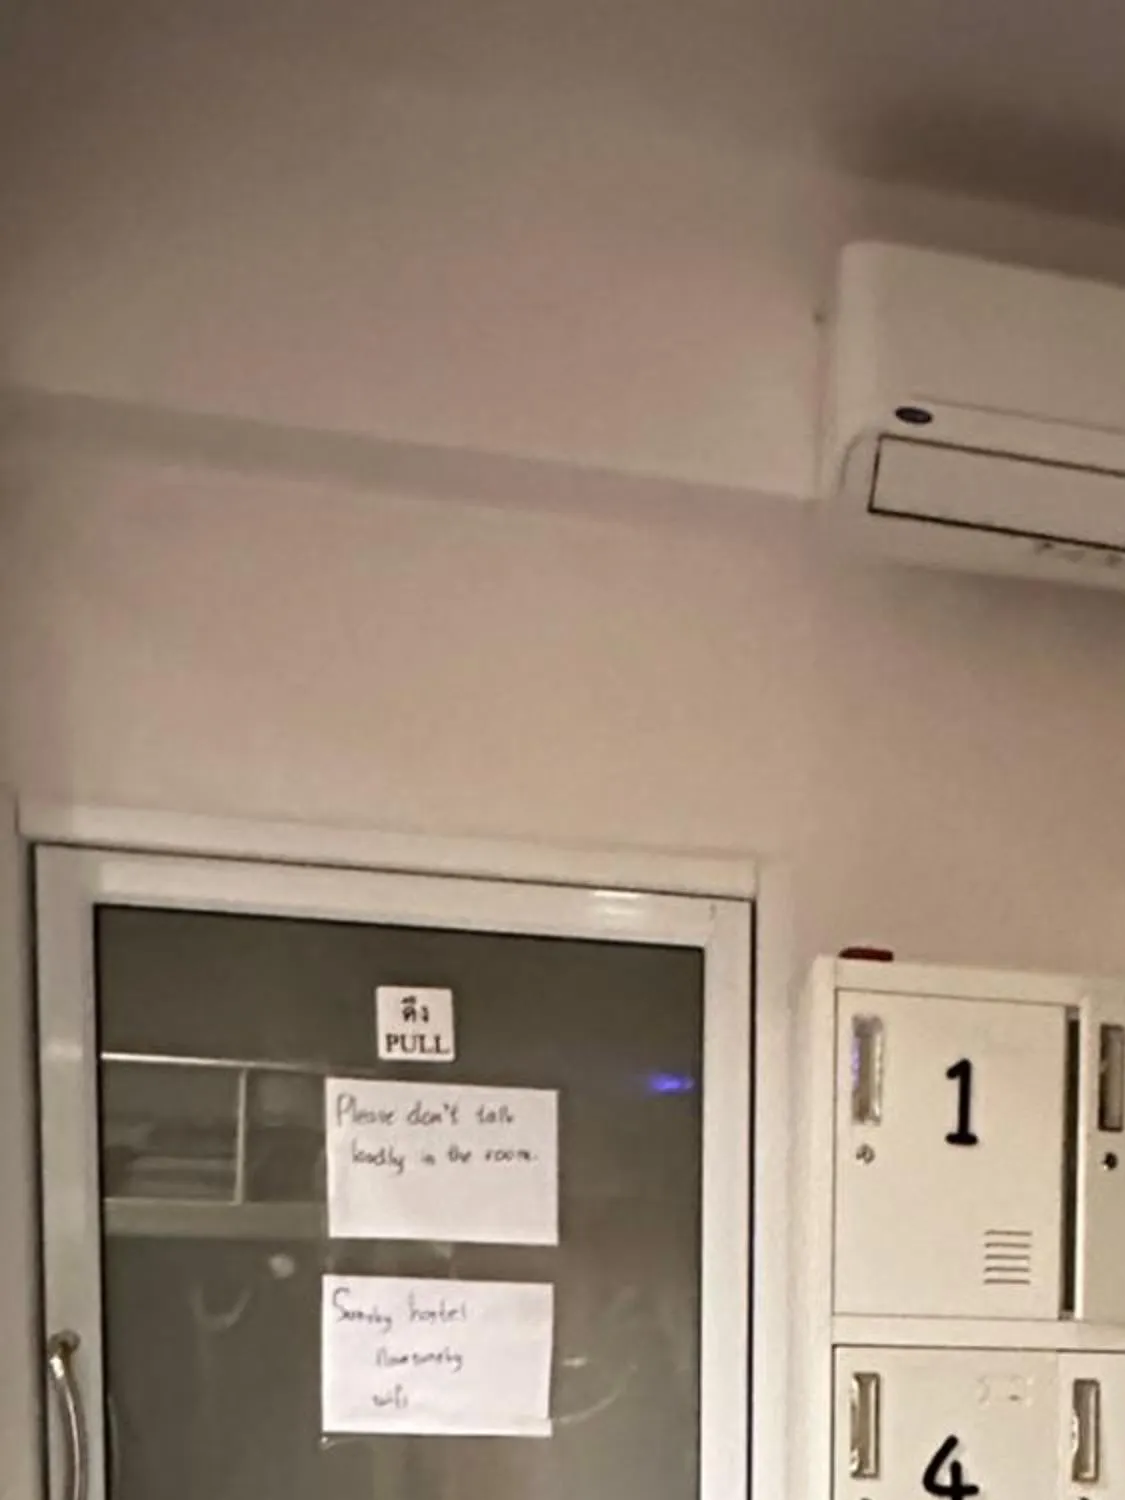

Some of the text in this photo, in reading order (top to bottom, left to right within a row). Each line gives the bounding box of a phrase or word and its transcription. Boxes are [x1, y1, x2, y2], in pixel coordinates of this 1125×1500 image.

[385, 1032, 451, 1055] PULL
[336, 1093, 396, 1127] Please
[406, 1100, 459, 1126] don't
[944, 1057, 978, 1147] 1
[408, 1291, 466, 1324] hostel
